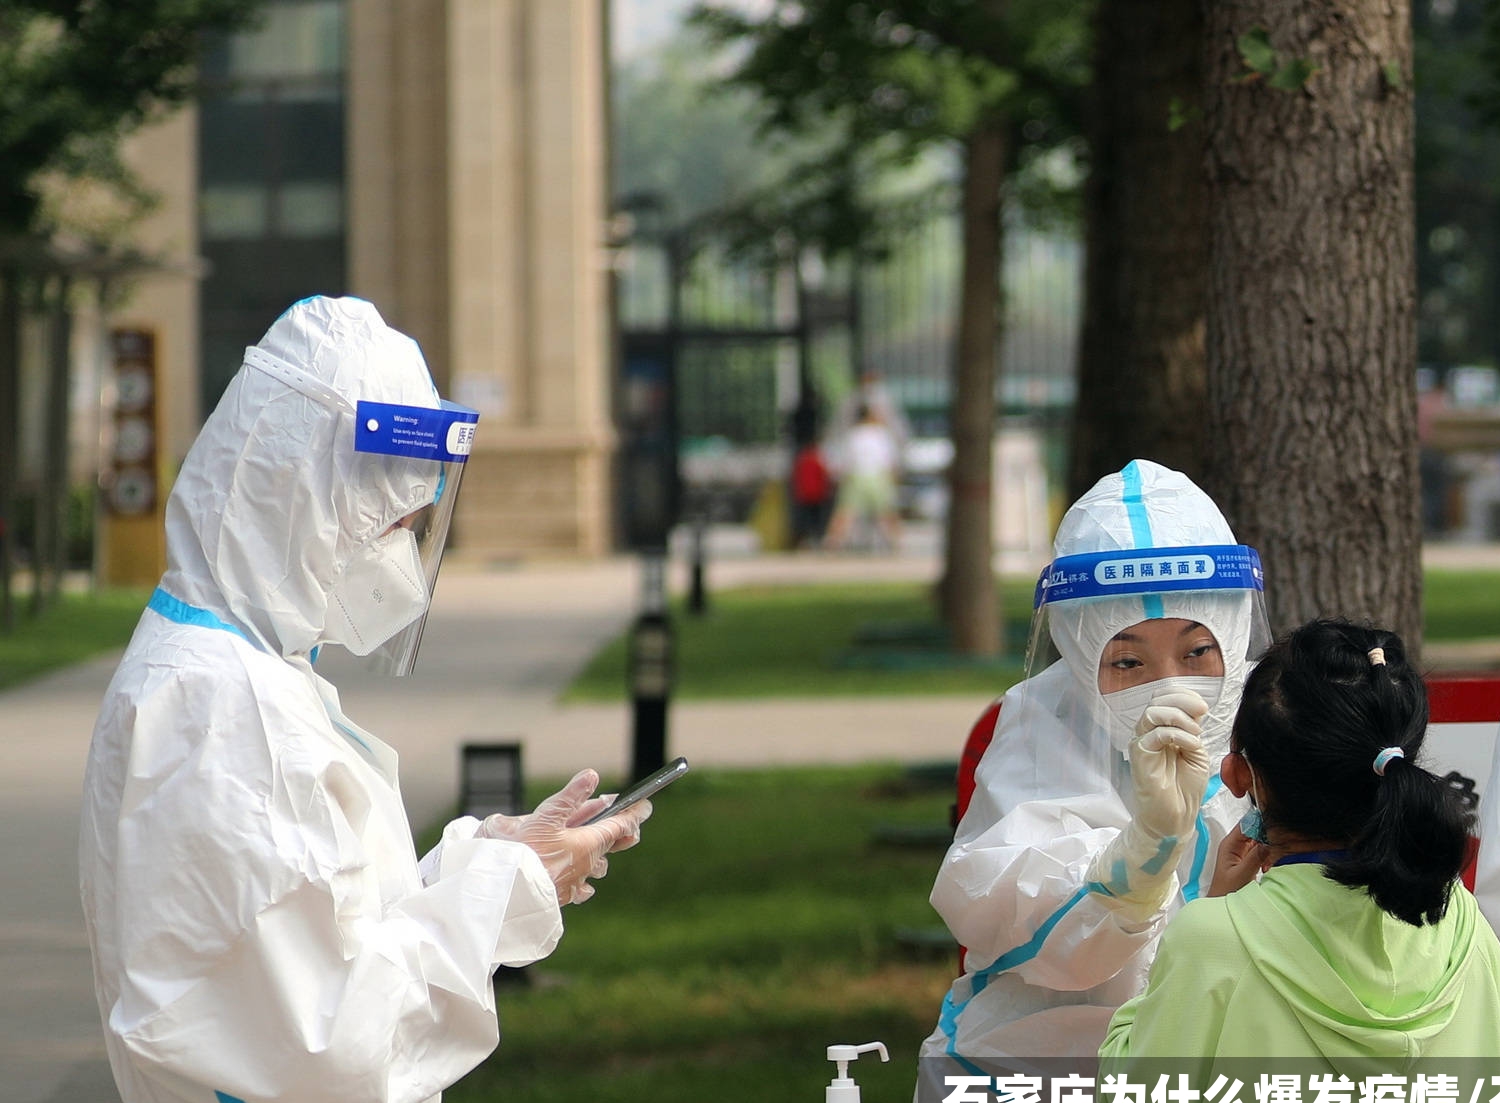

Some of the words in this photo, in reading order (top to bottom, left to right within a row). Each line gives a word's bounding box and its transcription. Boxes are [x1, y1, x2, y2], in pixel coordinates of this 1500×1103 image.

[393, 415, 419, 425] Warning:
[1103, 559, 1208, 580] 医用隔离面罩
